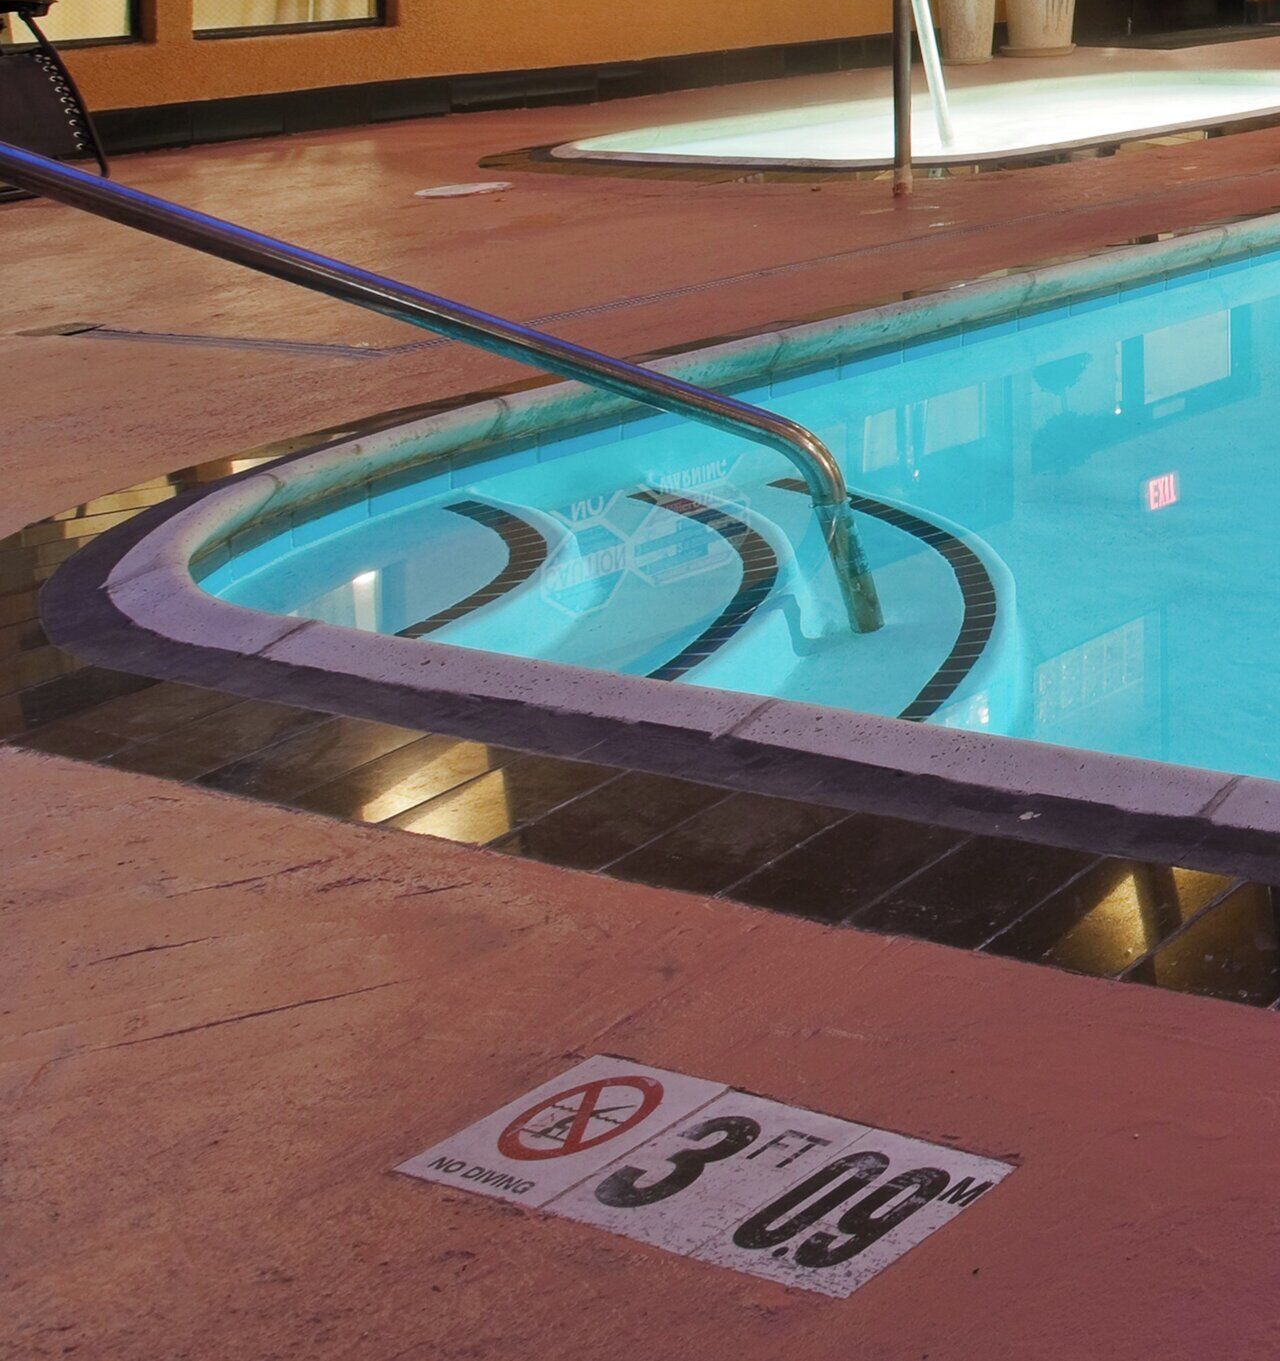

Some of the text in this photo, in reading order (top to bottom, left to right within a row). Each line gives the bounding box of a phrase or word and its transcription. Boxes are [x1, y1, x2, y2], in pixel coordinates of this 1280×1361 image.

[427, 1156, 536, 1195] NO DIVING
[595, 1116, 833, 1208] 3 FT
[939, 1177, 993, 1208] M
